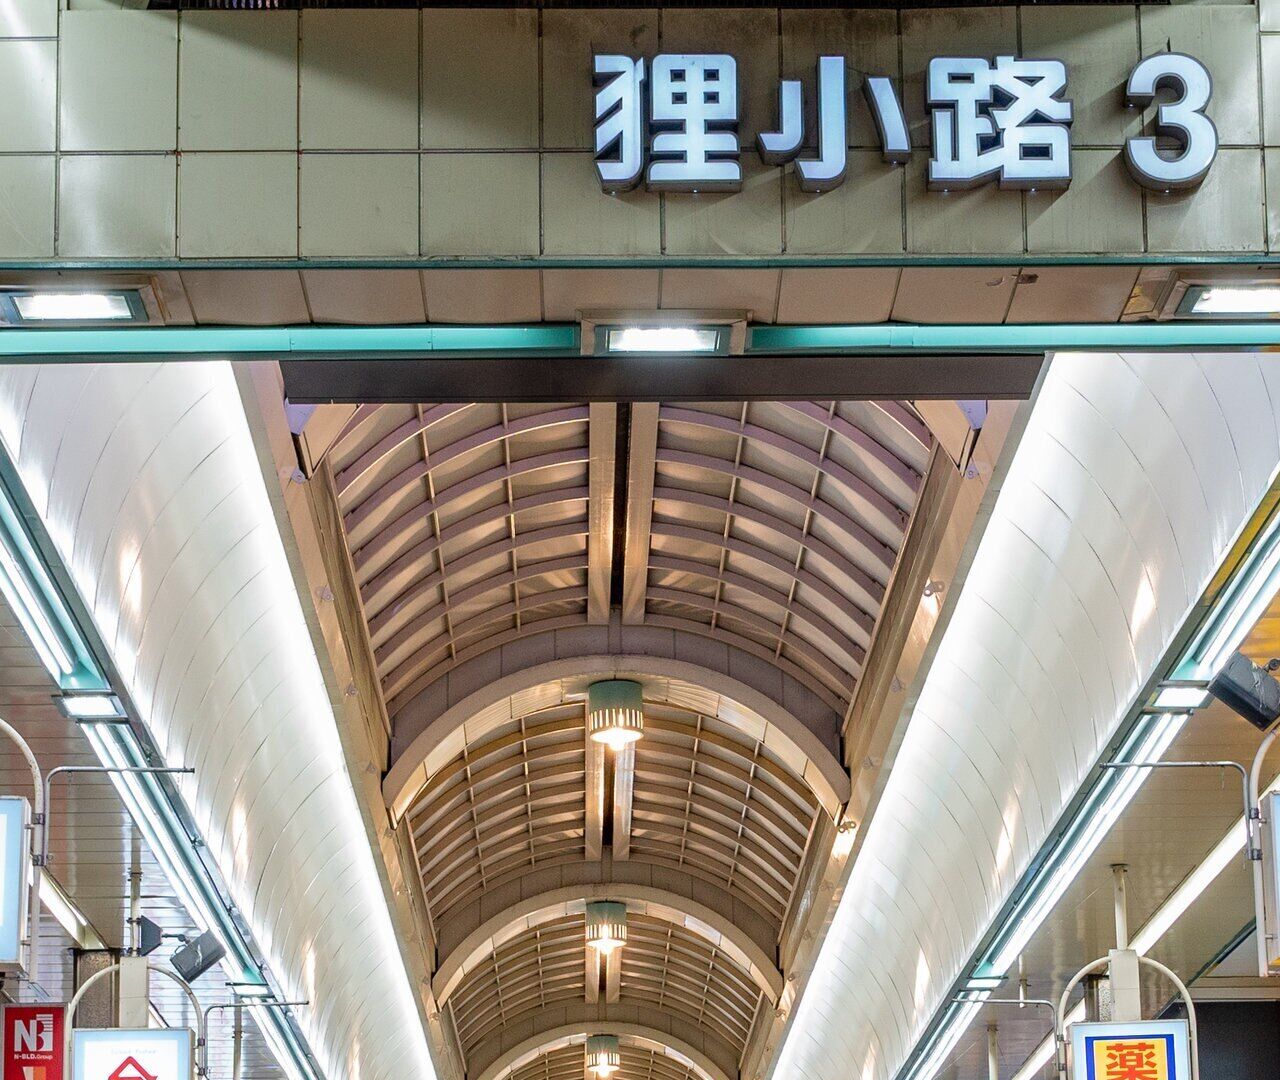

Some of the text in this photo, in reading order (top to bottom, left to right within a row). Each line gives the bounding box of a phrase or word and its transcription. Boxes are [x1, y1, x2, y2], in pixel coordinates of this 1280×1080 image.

[592, 51, 1220, 192] 狸小路 3
